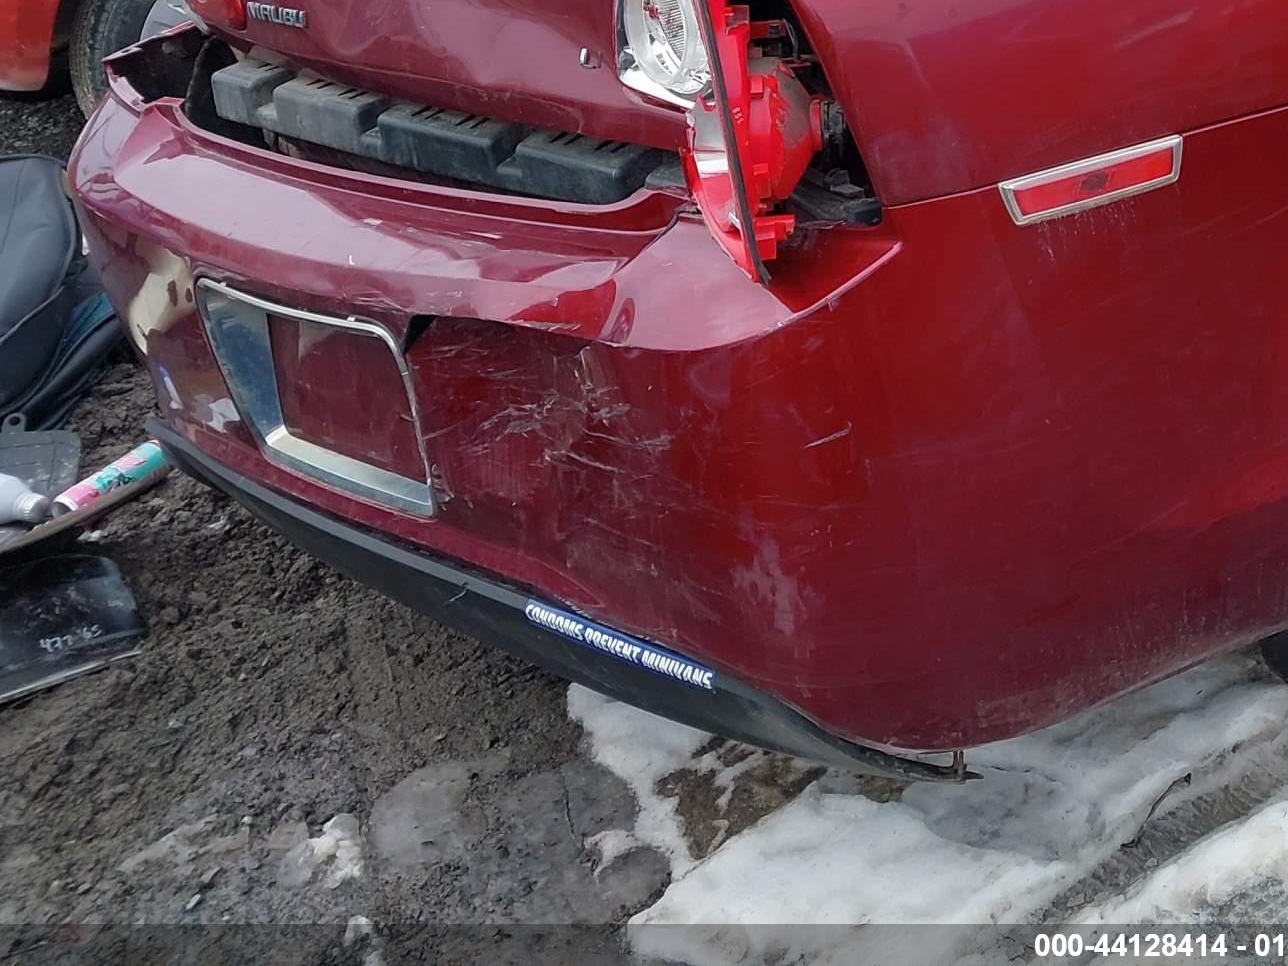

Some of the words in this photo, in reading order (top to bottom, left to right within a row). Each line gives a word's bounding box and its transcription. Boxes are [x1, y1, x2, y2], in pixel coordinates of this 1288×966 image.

[246, 1, 307, 27] MALIBU
[525, 604, 584, 641] CONDOMS
[584, 627, 642, 664] PREVENT
[641, 649, 714, 690] MINIVANS
